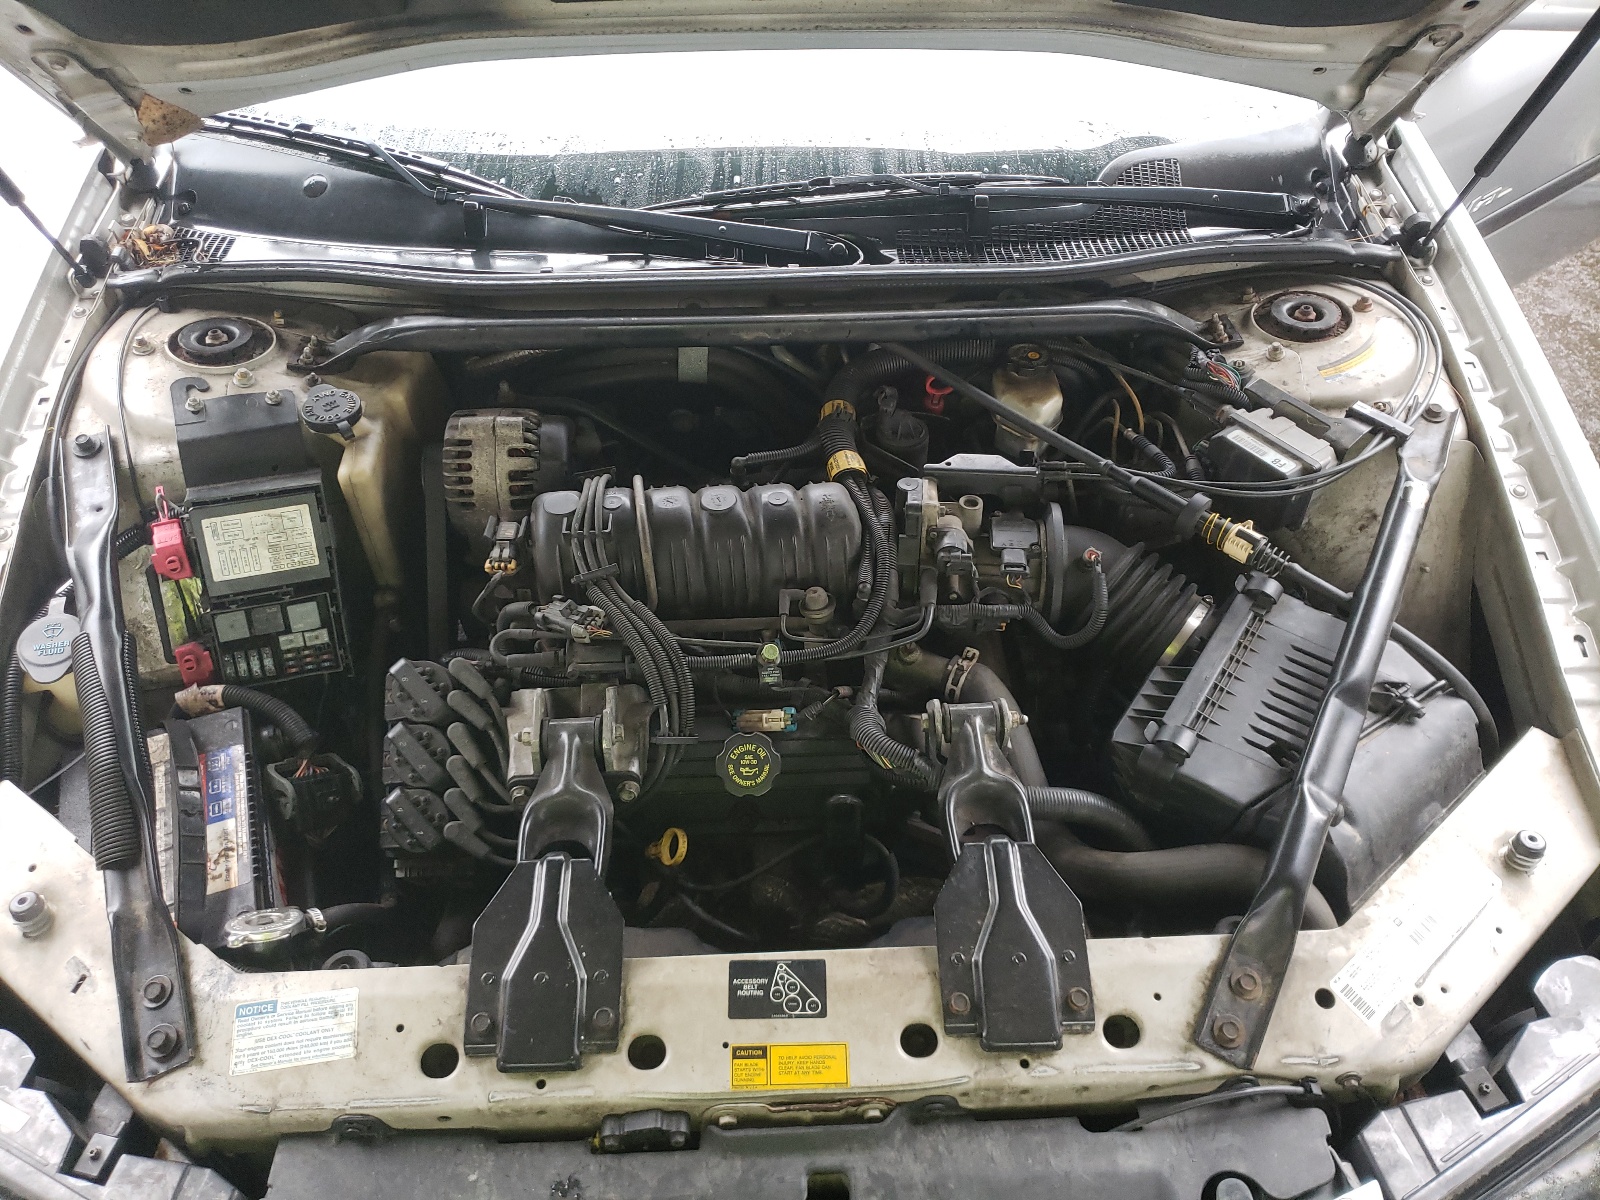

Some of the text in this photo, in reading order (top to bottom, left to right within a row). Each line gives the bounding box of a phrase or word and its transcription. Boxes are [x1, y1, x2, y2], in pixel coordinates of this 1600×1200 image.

[33, 640, 70, 651] WASHER
[38, 648, 64, 656] FLUID
[730, 744, 768, 760] ENGINE OIL
[728, 764, 770, 786] SEE OWNER'S MANUAL
[239, 1004, 274, 1016] NOTICE
